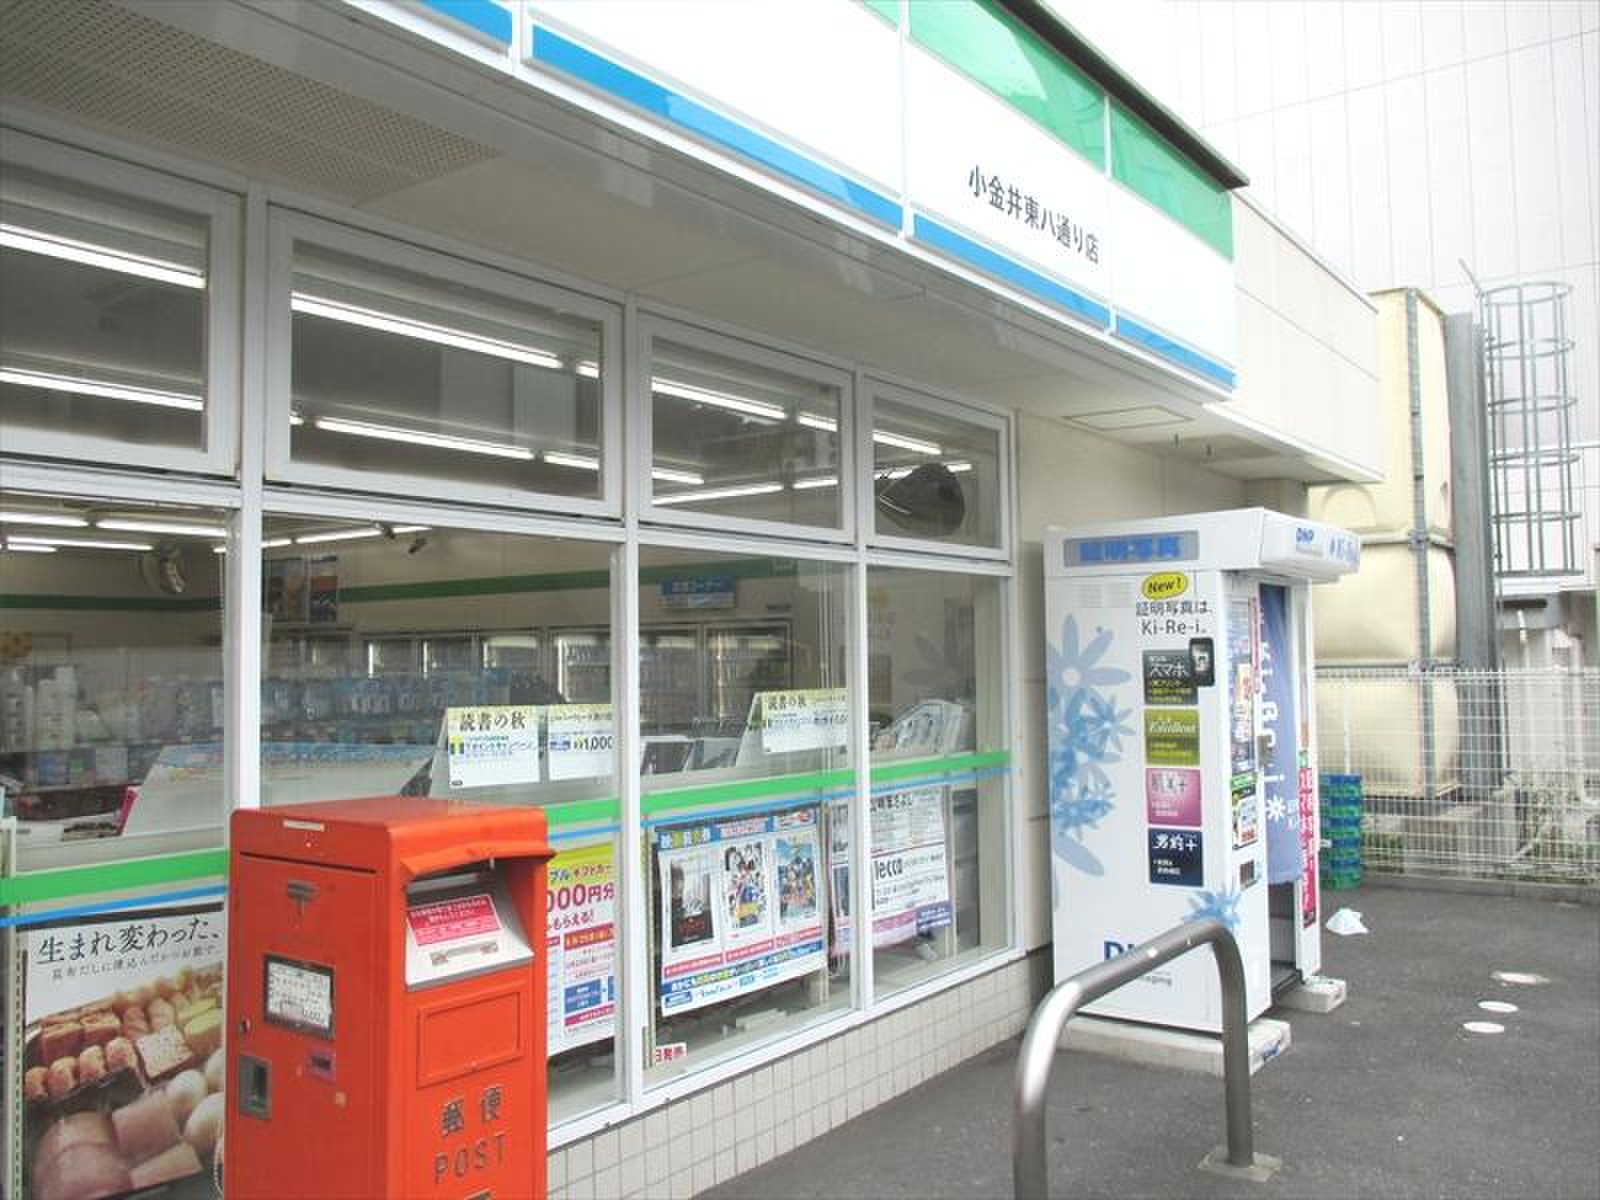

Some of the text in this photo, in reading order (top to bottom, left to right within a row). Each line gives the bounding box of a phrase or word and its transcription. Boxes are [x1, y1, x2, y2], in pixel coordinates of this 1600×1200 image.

[968, 164, 1100, 264] 小金井東八通り店
[1146, 574, 1182, 593] New!
[459, 709, 527, 732] 読書の秋
[36, 917, 219, 964] 生まれ変わった、
[434, 1134, 506, 1185] POST
